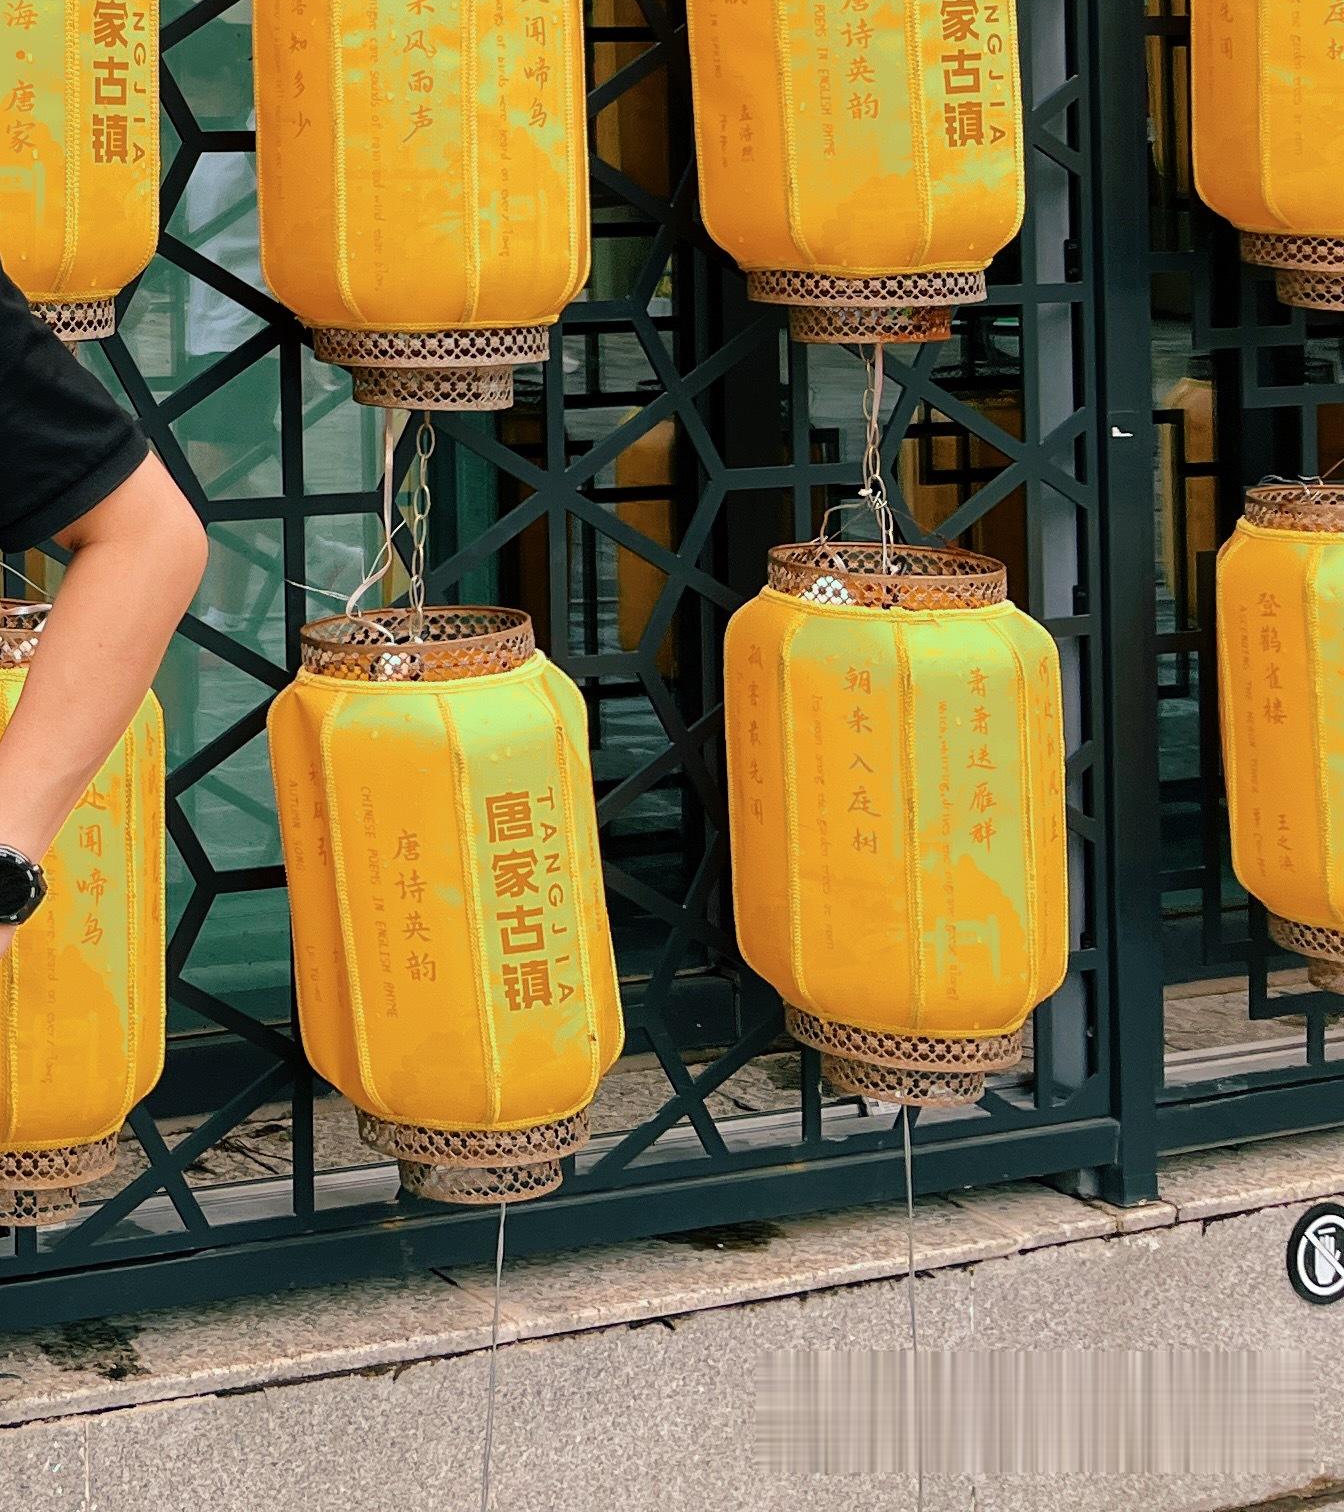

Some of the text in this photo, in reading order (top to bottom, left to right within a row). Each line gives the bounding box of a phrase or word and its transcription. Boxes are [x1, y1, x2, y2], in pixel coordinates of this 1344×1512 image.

[814, 4, 827, 37] POEMS
[817, 48, 828, 60] IN
[818, 68, 831, 115] ENGLISH
[822, 123, 836, 157] RHYME
[1257, 592, 1288, 725] 登鹳雀楼
[844, 666, 881, 855] 朝来入庭树
[967, 667, 998, 854] 萧萧送雁群
[360, 787, 398, 1018] CHINESE POEMS IN ENGLISH RHYME
[393, 828, 437, 983] 唐诗英韵
[486, 791, 553, 1011] 唐家古镇
[537, 788, 574, 1004] TANGJIA
